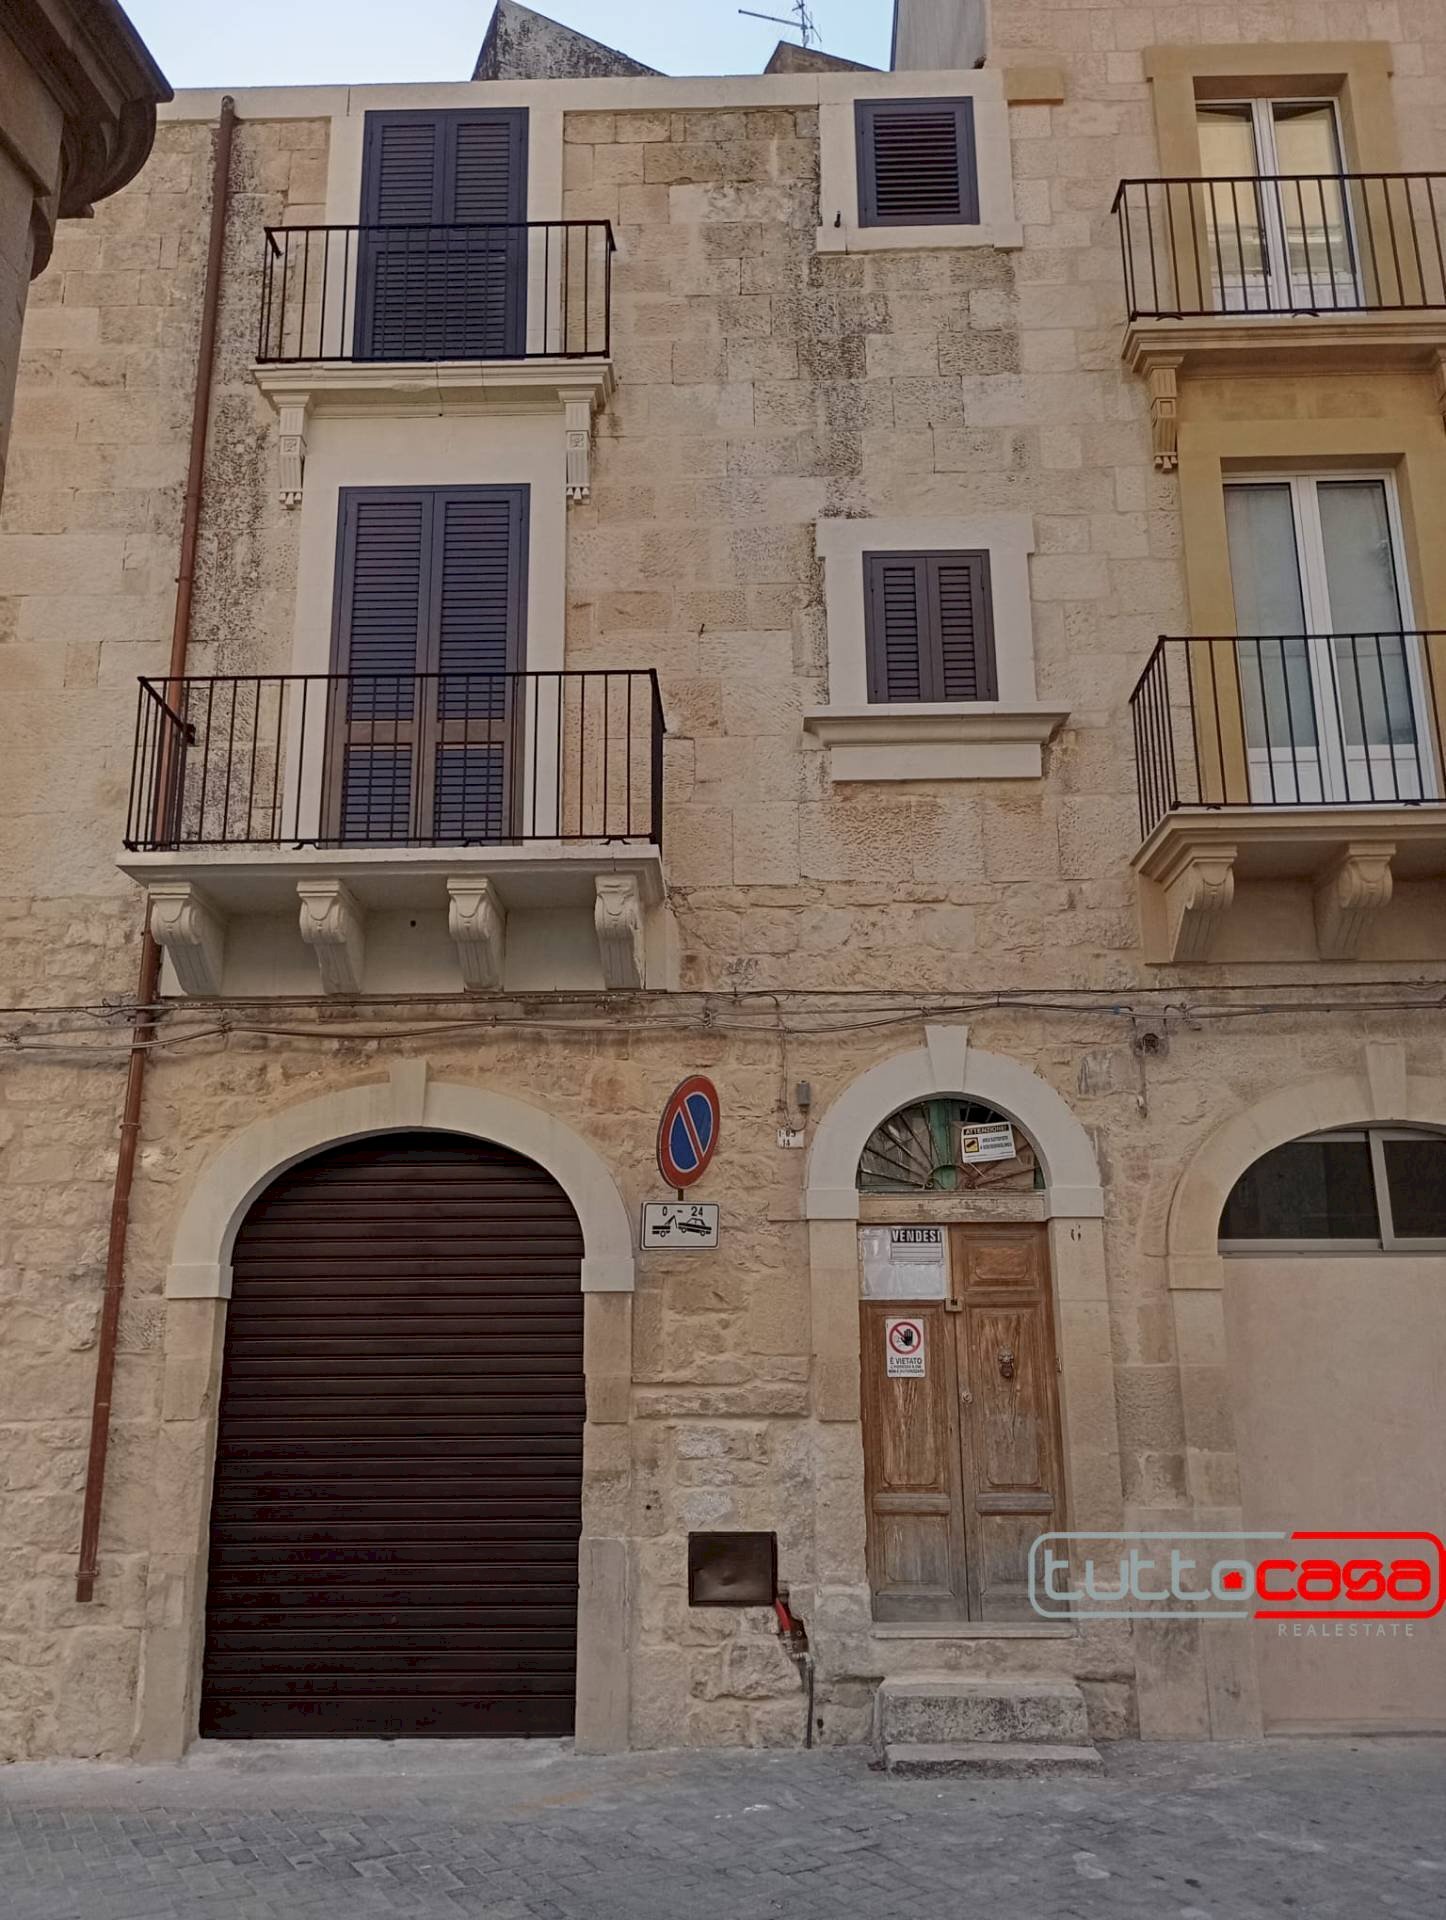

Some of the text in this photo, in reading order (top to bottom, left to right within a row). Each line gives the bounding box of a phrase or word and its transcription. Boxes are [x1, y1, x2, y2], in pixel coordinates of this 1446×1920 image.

[691, 1206, 703, 1217] 24
[892, 1230, 941, 1242] VENDESI
[895, 1357, 922, 1365] VIETATO
